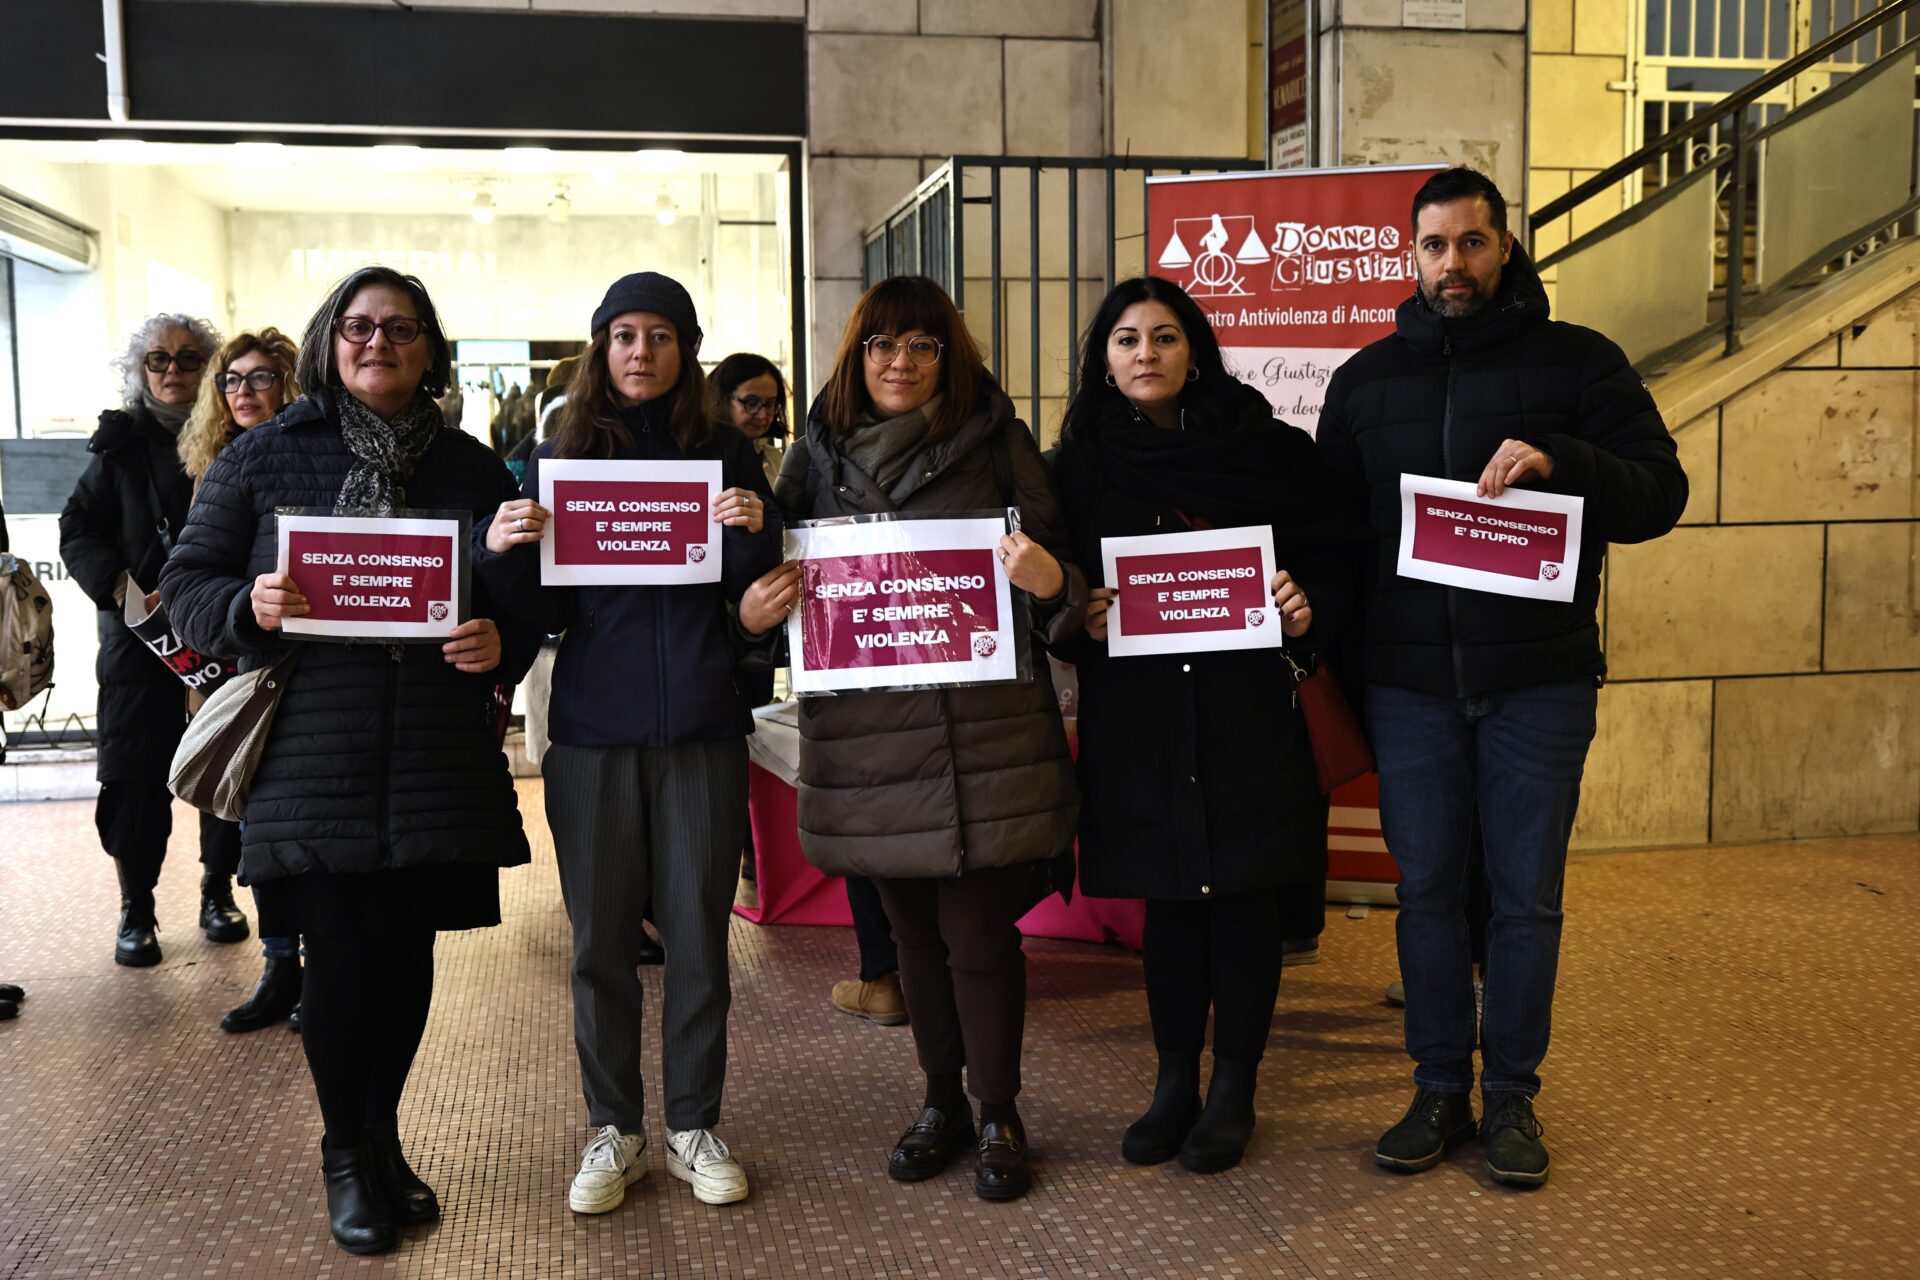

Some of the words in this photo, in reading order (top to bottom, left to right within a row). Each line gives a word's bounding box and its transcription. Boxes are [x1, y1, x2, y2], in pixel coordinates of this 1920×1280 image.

[1379, 227, 1398, 247] &
[1277, 252, 1413, 284] Giustizi
[1206, 310, 1235, 327] ntro
[1239, 307, 1328, 327] Antiviolenza
[1332, 306, 1345, 324] di
[1350, 305, 1396, 324] Ancon
[1263, 356, 1335, 388] Giustizi
[566, 501, 616, 512] SENZA
[619, 501, 700, 512] CONSENSO
[596, 522, 608, 532] E'
[612, 522, 671, 532] SEMPRE
[1427, 507, 1474, 522] SENZA
[1477, 516, 1558, 536] CONSENSO
[1454, 526, 1466, 536] E'
[1470, 529, 1528, 546] STUPRO
[597, 541, 671, 551] VIOLENZA
[302, 553, 354, 565] SENZA
[358, 554, 444, 568] CONSENSO
[333, 575, 346, 586] E'
[350, 576, 412, 587] SEMPRE
[1129, 572, 1175, 585] SENZA
[1178, 567, 1256, 582] CONSENSO
[816, 581, 876, 599] SENZA
[880, 575, 985, 594] CONSENSO
[1158, 592, 1169, 602] E'
[1173, 588, 1229, 602] SEMPRE
[333, 595, 411, 607] VIOLENZA
[852, 609, 867, 623] E'
[872, 604, 950, 621] SEMPRE
[1160, 607, 1230, 621] VIOLENZA
[855, 630, 950, 648] VIOLENZA
